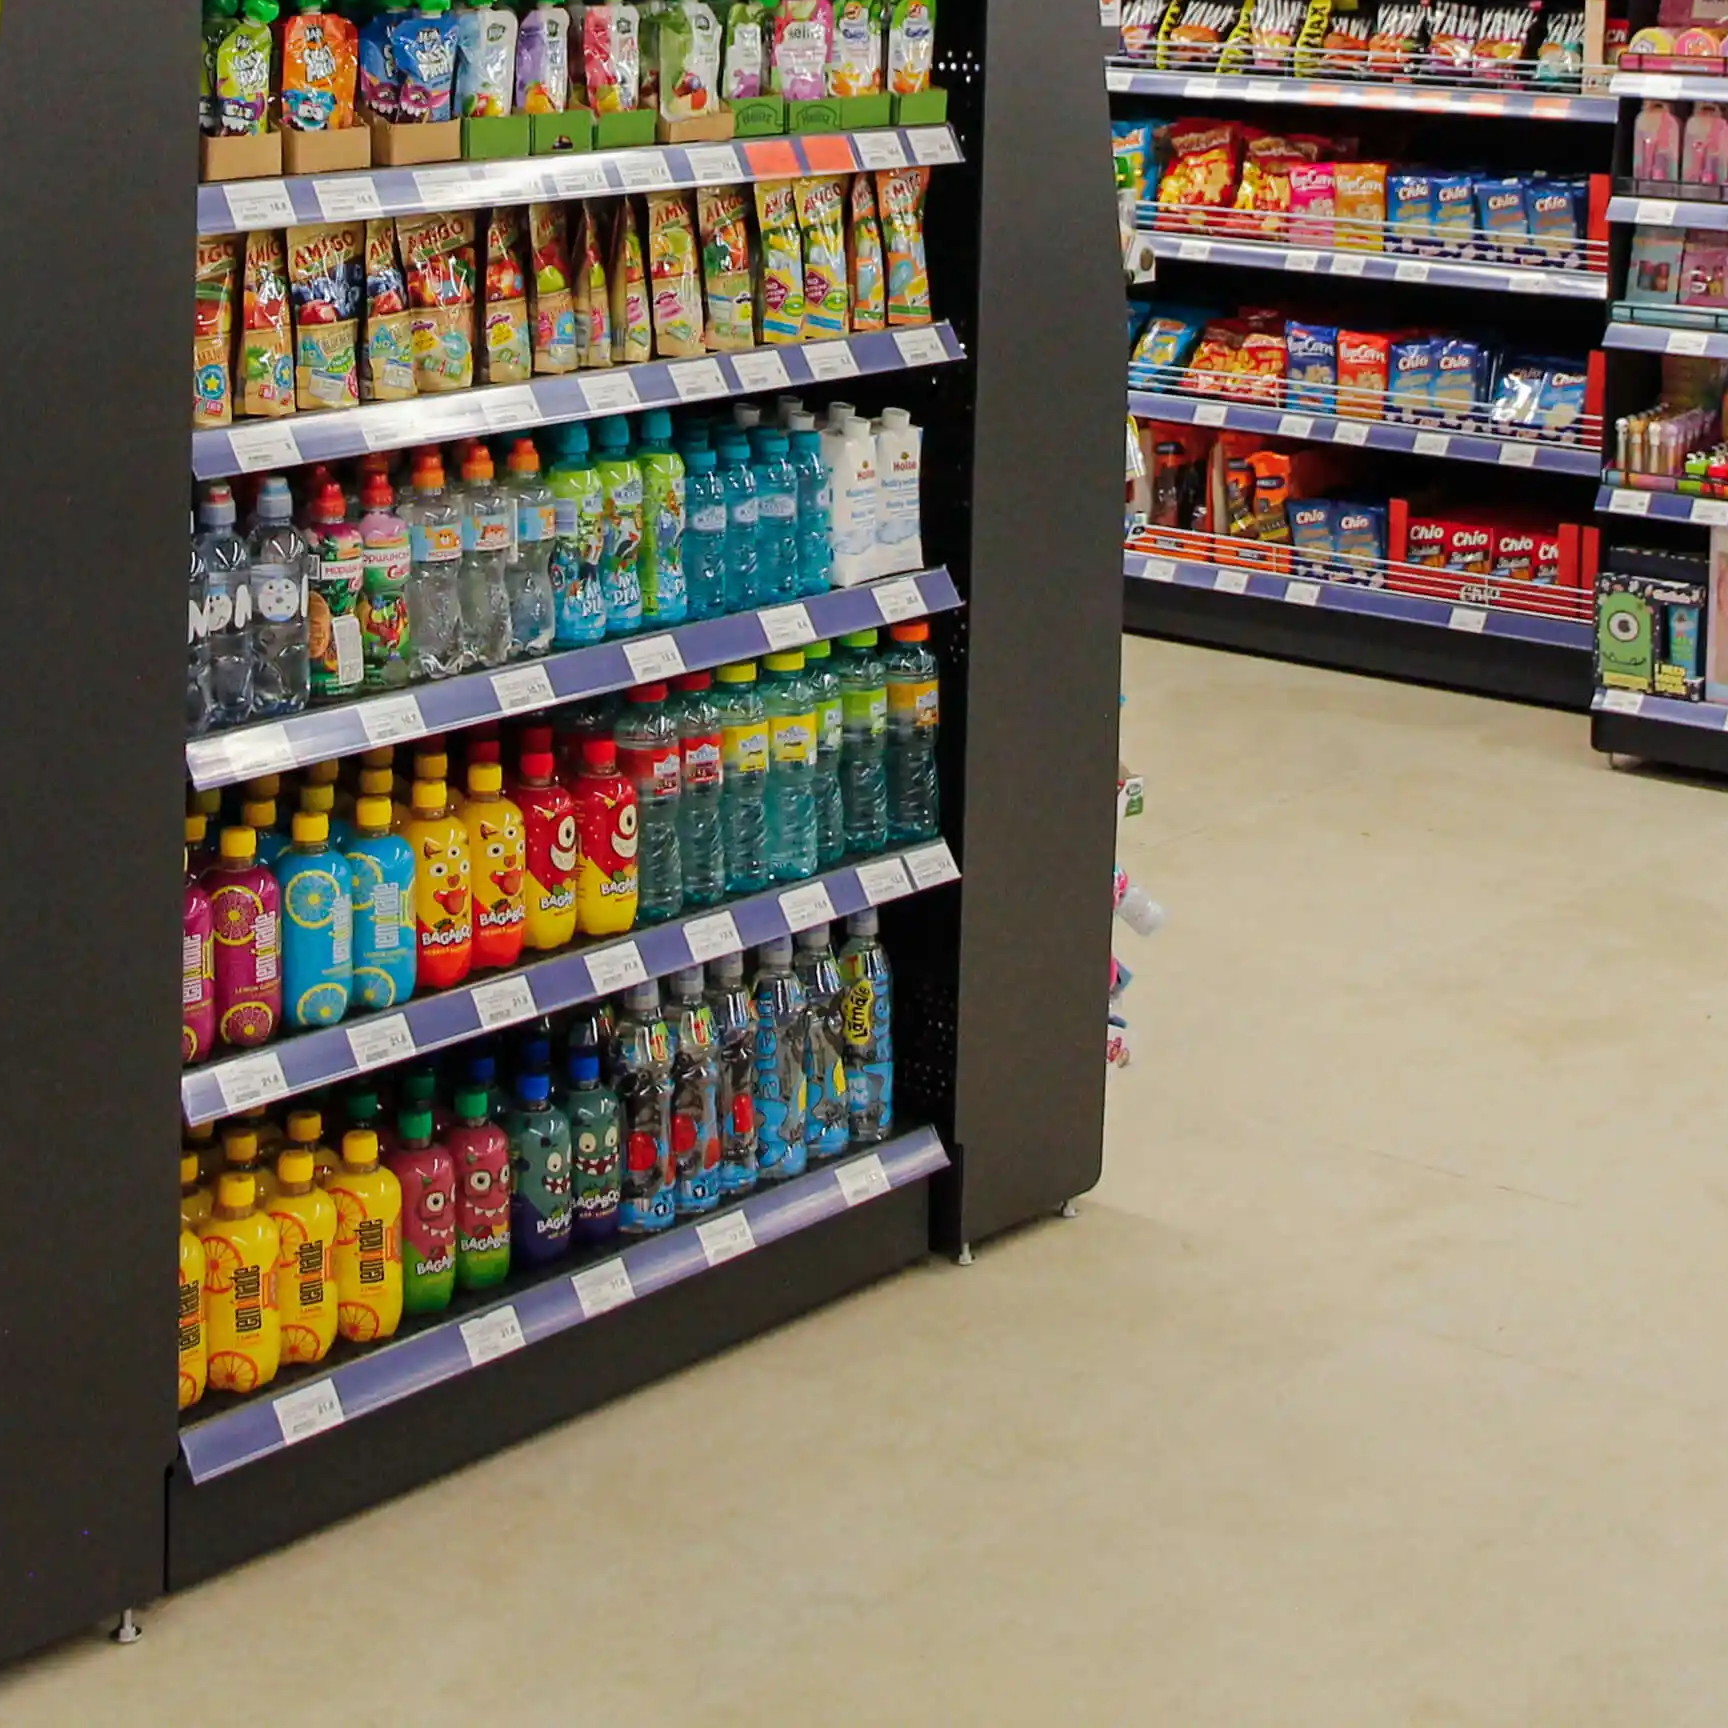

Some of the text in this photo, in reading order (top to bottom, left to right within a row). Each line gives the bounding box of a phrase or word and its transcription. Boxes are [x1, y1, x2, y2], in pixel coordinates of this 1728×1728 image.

[1398, 184, 1428, 200] Chio
[1439, 186, 1468, 201] Chio
[1488, 194, 1518, 210] Chio
[1536, 196, 1566, 212] Chio
[655, 204, 687, 226] AMI
[407, 219, 464, 255] AMIGO
[294, 230, 355, 268] AMIGO
[1398, 355, 1429, 370] Chio
[1439, 355, 1470, 370] Chio
[1296, 509, 1325, 525] Chio
[1341, 515, 1369, 530] Chio
[1410, 525, 1444, 541] Chio
[1452, 531, 1488, 547] Chio
[1499, 536, 1533, 553] Chio
[1538, 544, 1558, 560] Ch
[1460, 584, 1501, 601] Chio
